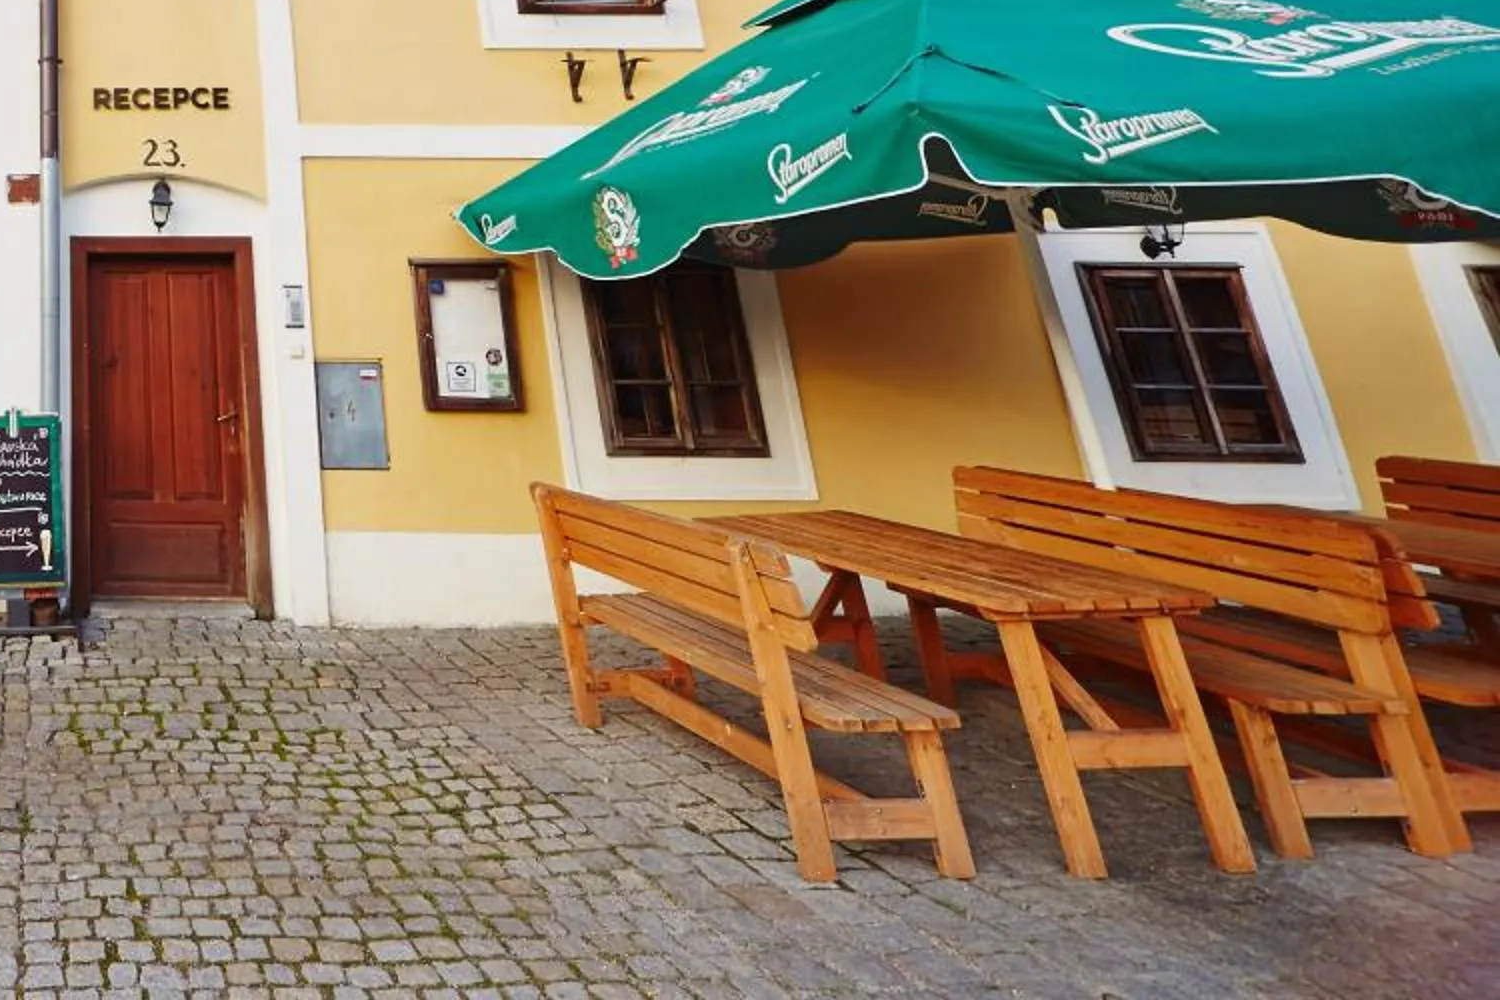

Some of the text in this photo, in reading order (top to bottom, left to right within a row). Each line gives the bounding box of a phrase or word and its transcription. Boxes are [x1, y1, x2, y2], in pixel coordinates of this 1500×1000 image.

[92, 86, 230, 111] RECEPCE
[142, 138, 187, 168] 23.
[1047, 105, 1220, 165] Staropramen
[767, 131, 853, 204] Staropramen
